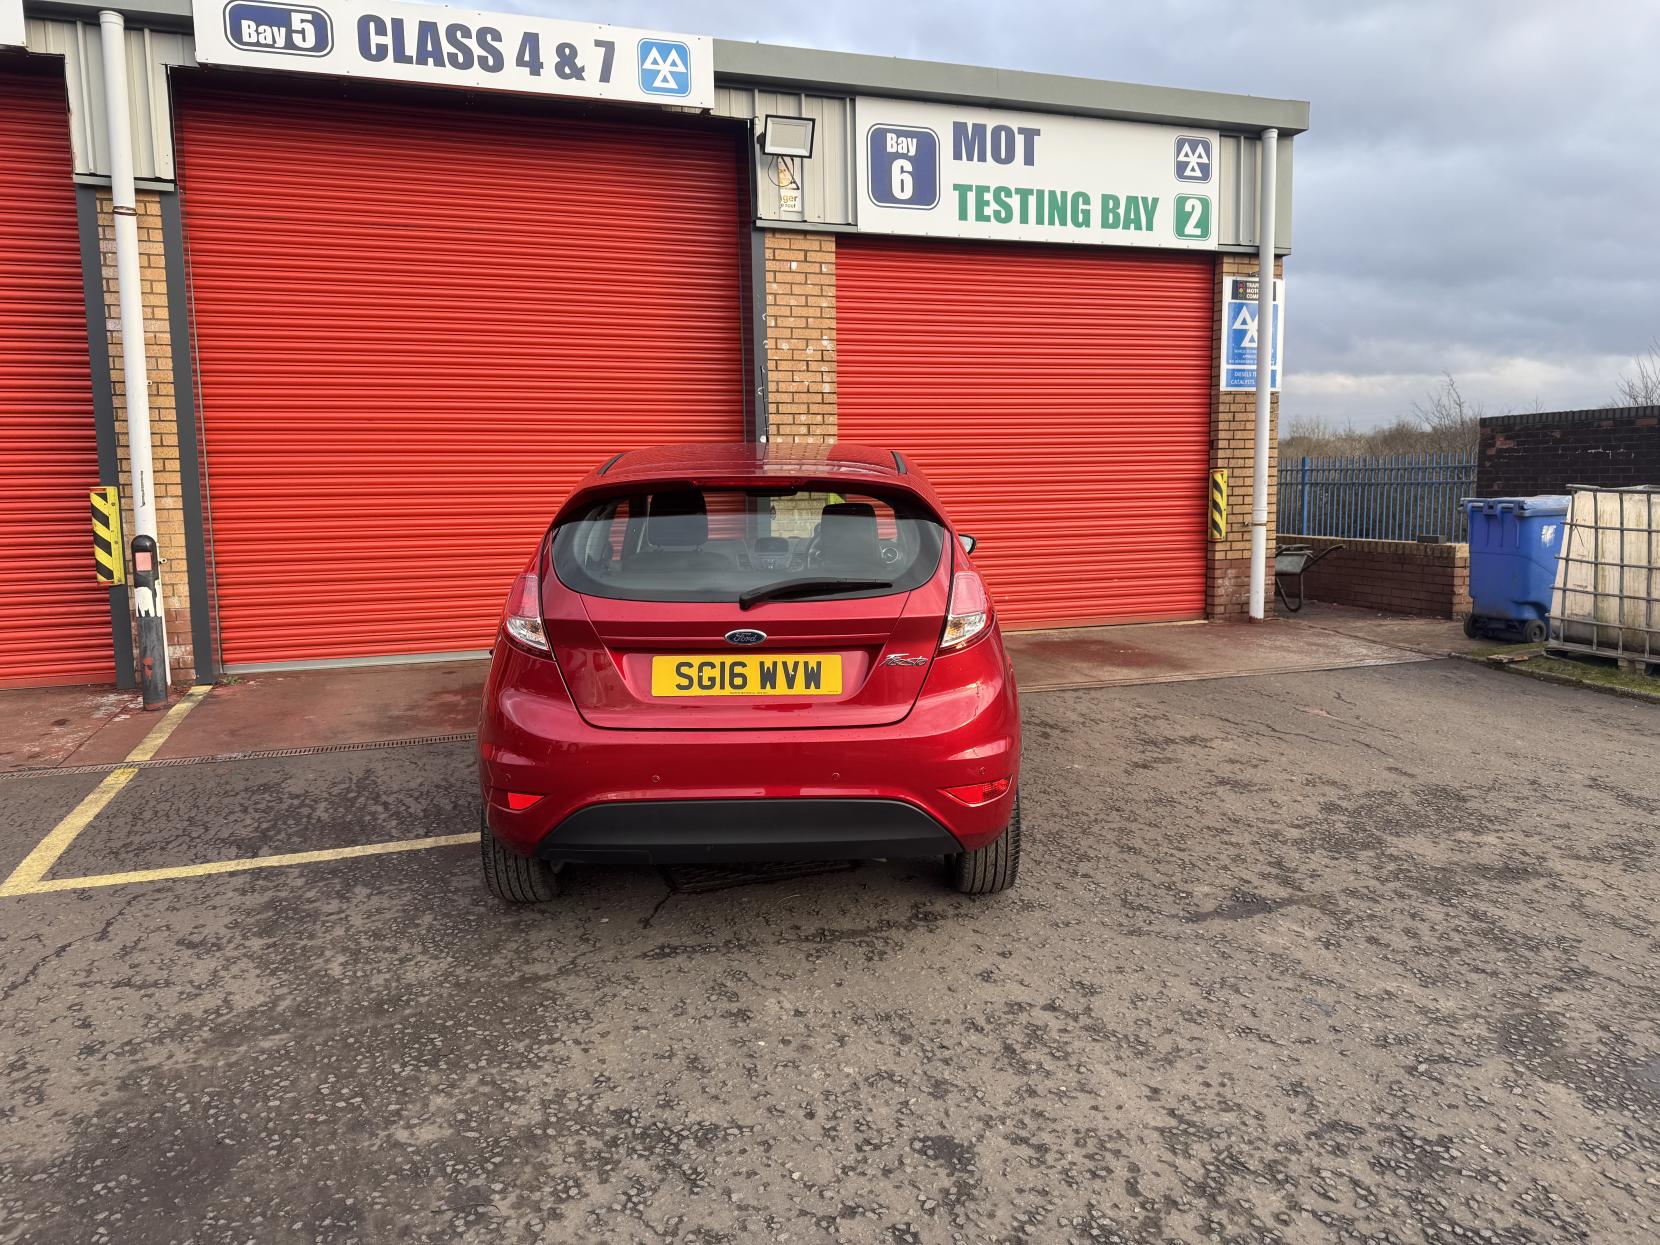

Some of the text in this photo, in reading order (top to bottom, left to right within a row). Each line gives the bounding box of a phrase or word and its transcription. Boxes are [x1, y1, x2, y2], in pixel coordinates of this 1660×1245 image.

[241, 11, 316, 49] Bay 5
[357, 13, 616, 84] CLASS 4 & 7
[886, 132, 917, 156] Bay
[952, 120, 1041, 167] MOT
[891, 158, 914, 200] 6
[952, 183, 1160, 232] TESTING BAY
[1183, 197, 1203, 236] 2
[733, 632, 758, 642] Ford
[675, 660, 822, 690] SG16 WVW
